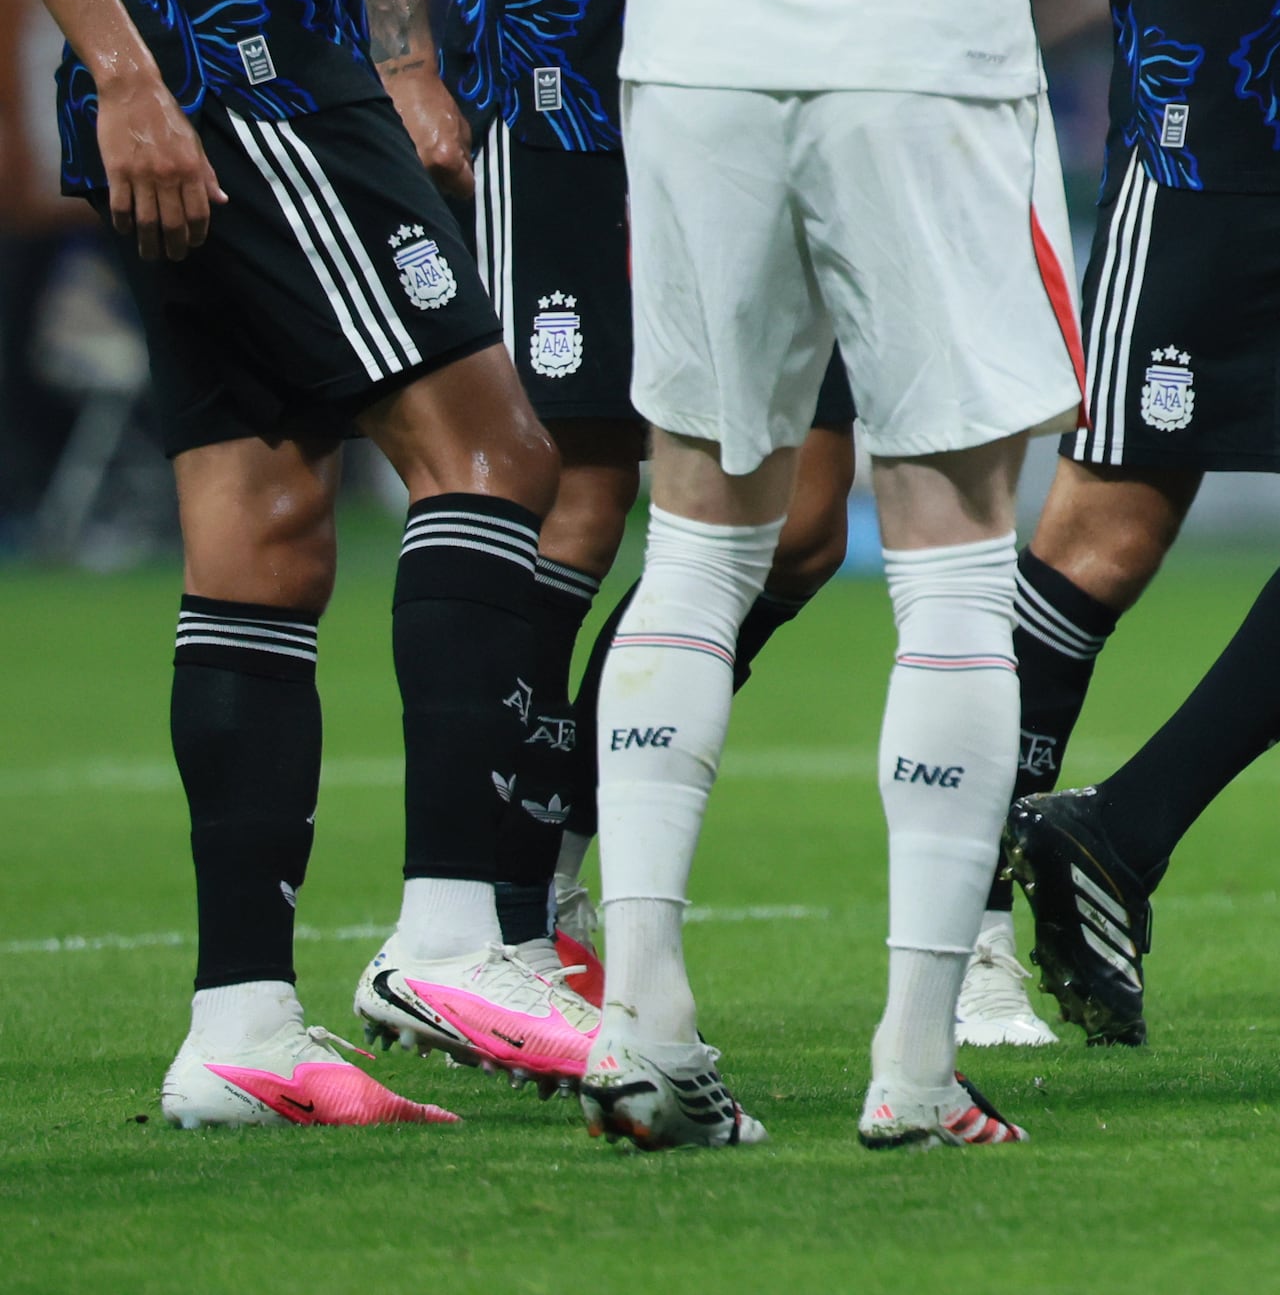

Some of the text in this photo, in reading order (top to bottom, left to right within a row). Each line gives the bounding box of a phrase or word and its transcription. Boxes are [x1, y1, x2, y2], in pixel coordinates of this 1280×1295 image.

[412, 259, 442, 289] AFA
[542, 330, 571, 358] AFA
[1152, 384, 1182, 412] AFA
[611, 726, 677, 751] ENG
[1019, 727, 1056, 776] FA
[894, 756, 965, 788] ENG
